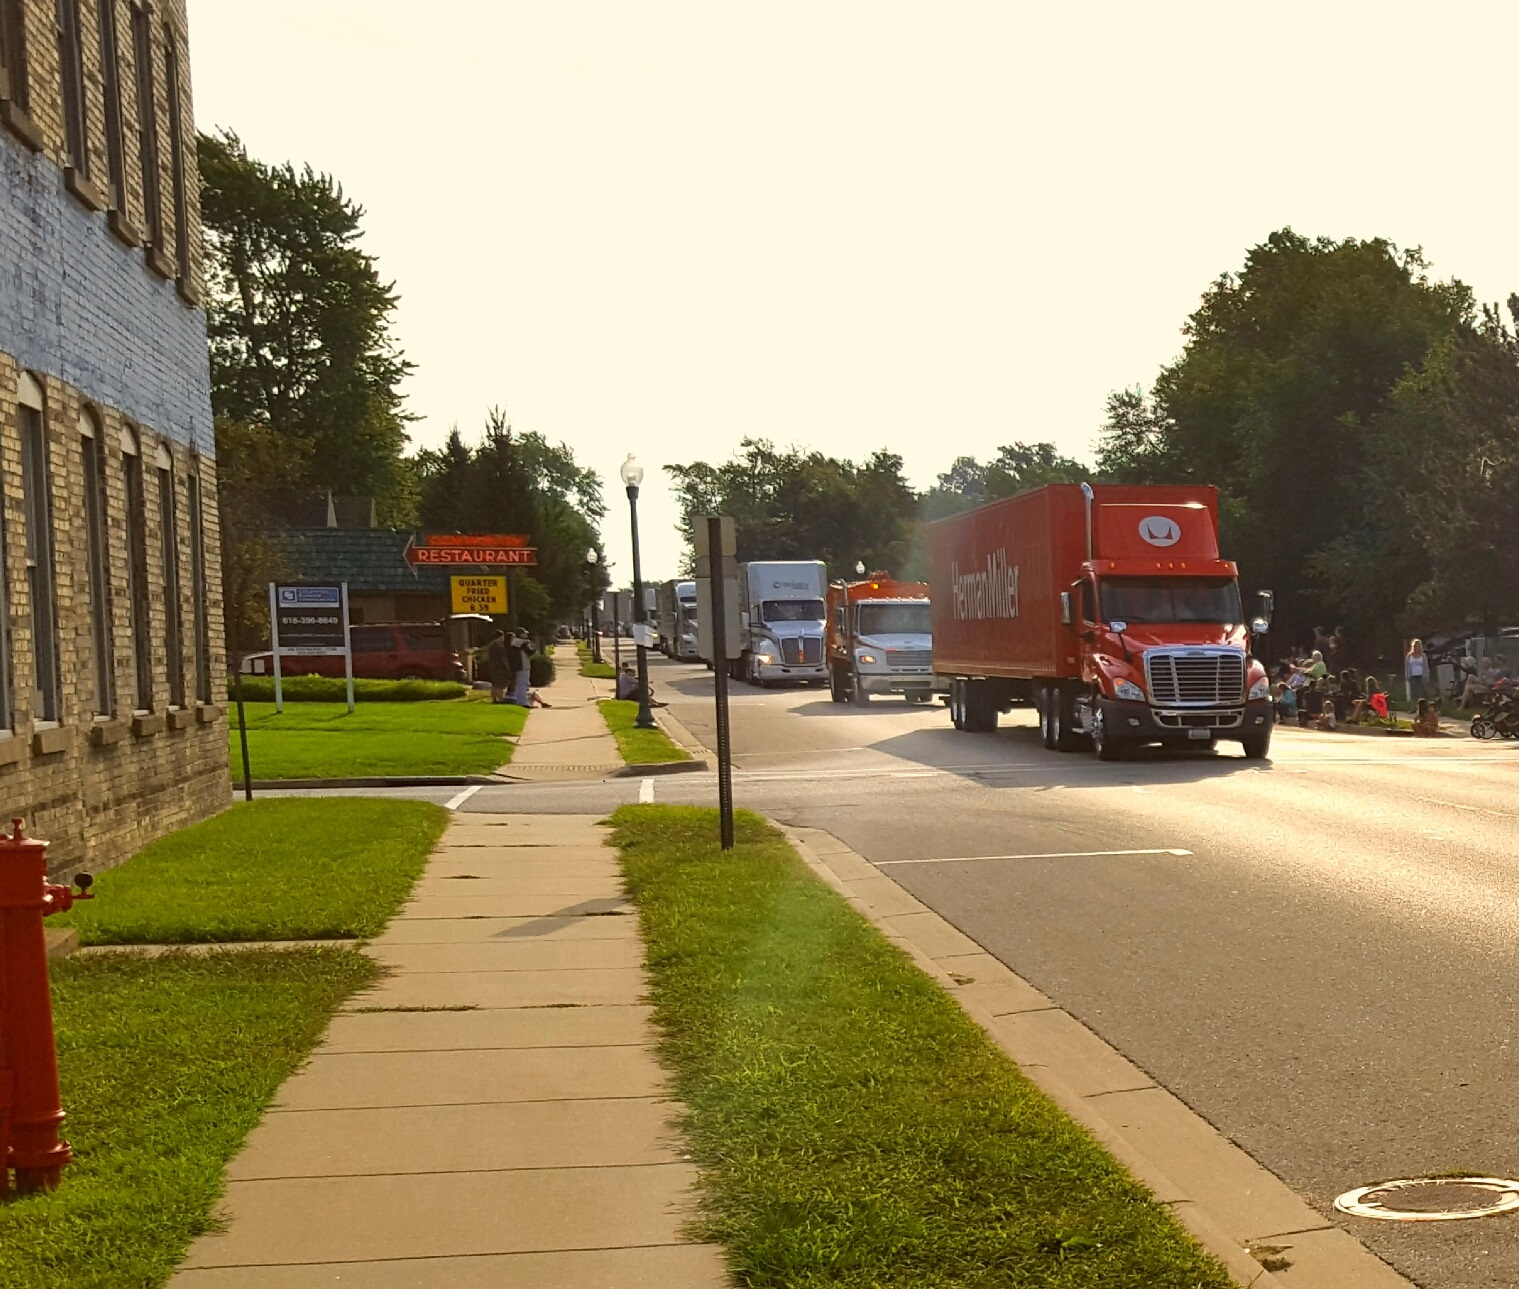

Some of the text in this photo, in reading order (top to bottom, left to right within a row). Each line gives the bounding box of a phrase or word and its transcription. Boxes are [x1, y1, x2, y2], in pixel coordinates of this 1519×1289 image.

[417, 549, 531, 562] RESTAURANT
[458, 579, 498, 587] QUARTER
[466, 587, 490, 595] FRIED
[461, 595, 497, 603] CHICKEN
